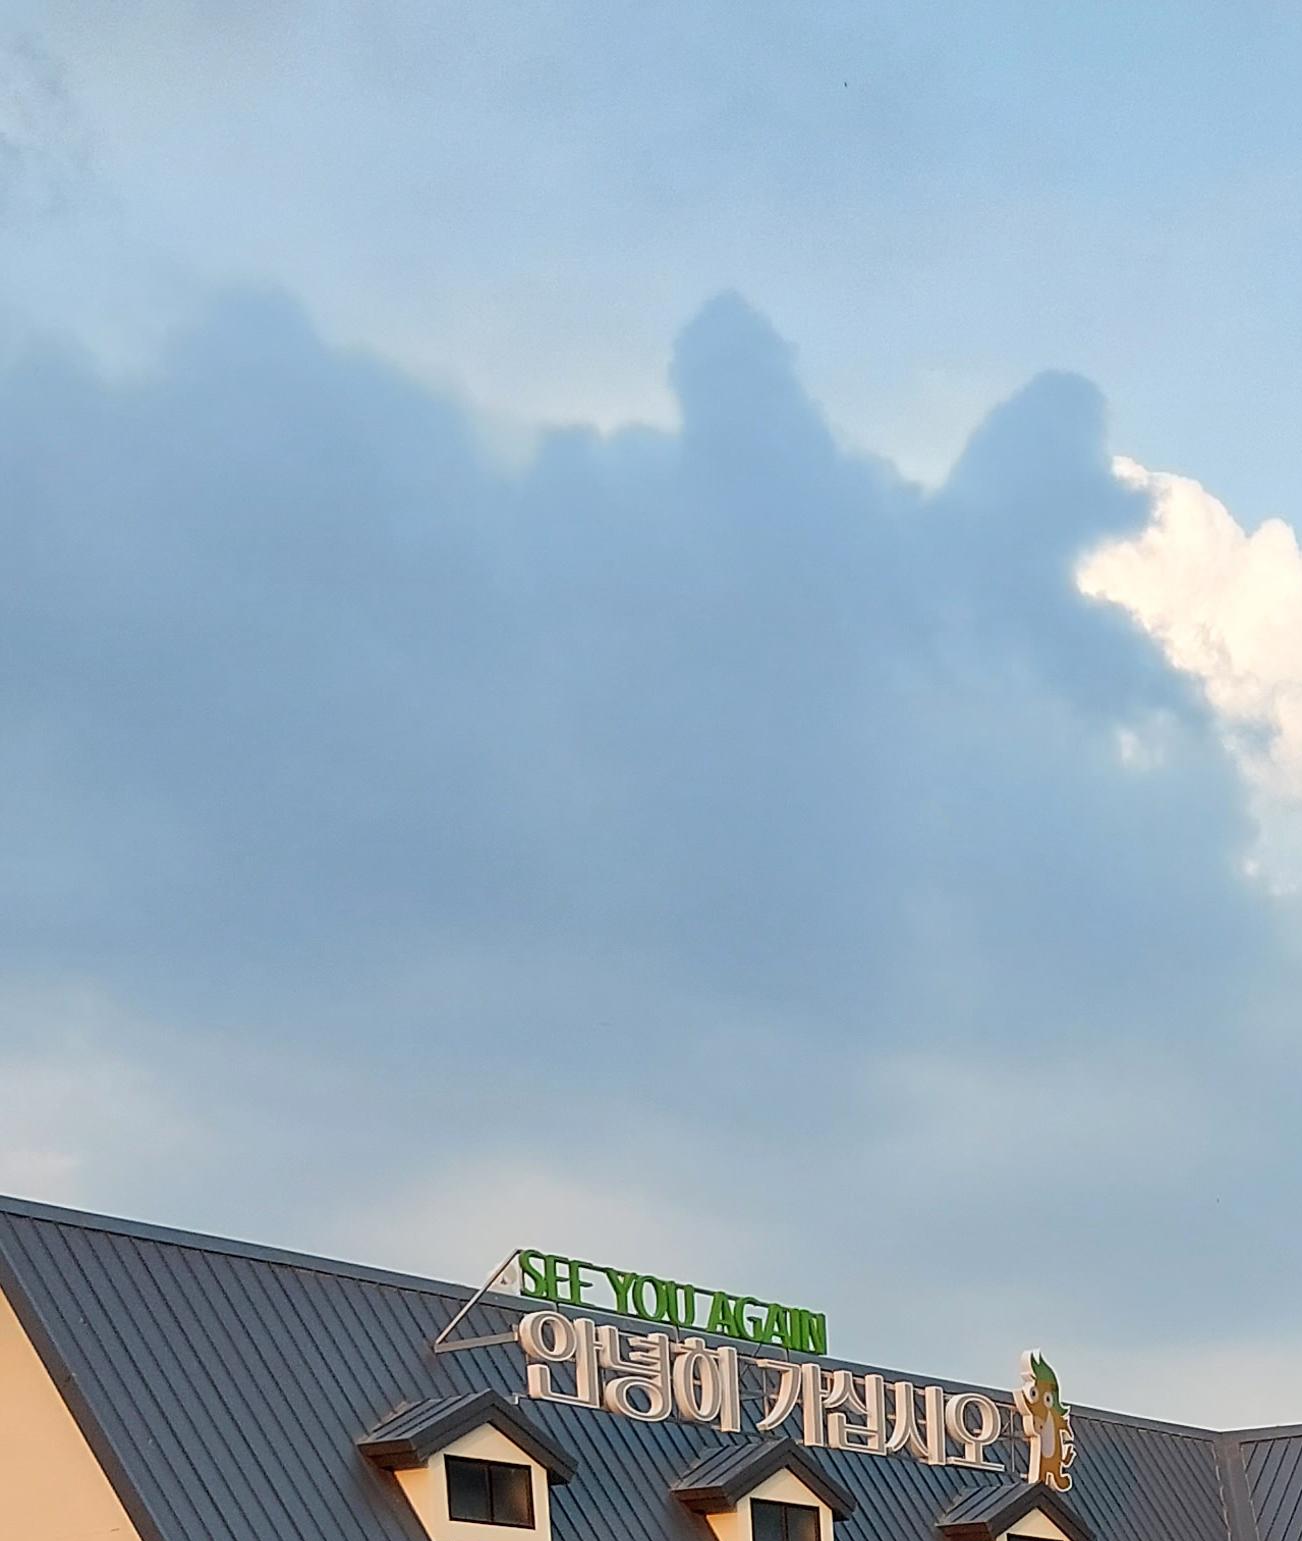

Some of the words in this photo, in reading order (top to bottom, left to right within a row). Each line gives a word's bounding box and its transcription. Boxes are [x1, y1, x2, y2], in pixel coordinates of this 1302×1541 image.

[519, 1250, 594, 1306] SEE
[606, 1267, 695, 1328] YOU
[706, 1291, 828, 1355] AGAIN
[519, 1311, 742, 1432] 안녕히
[755, 1358, 1005, 1471] 가십시오
